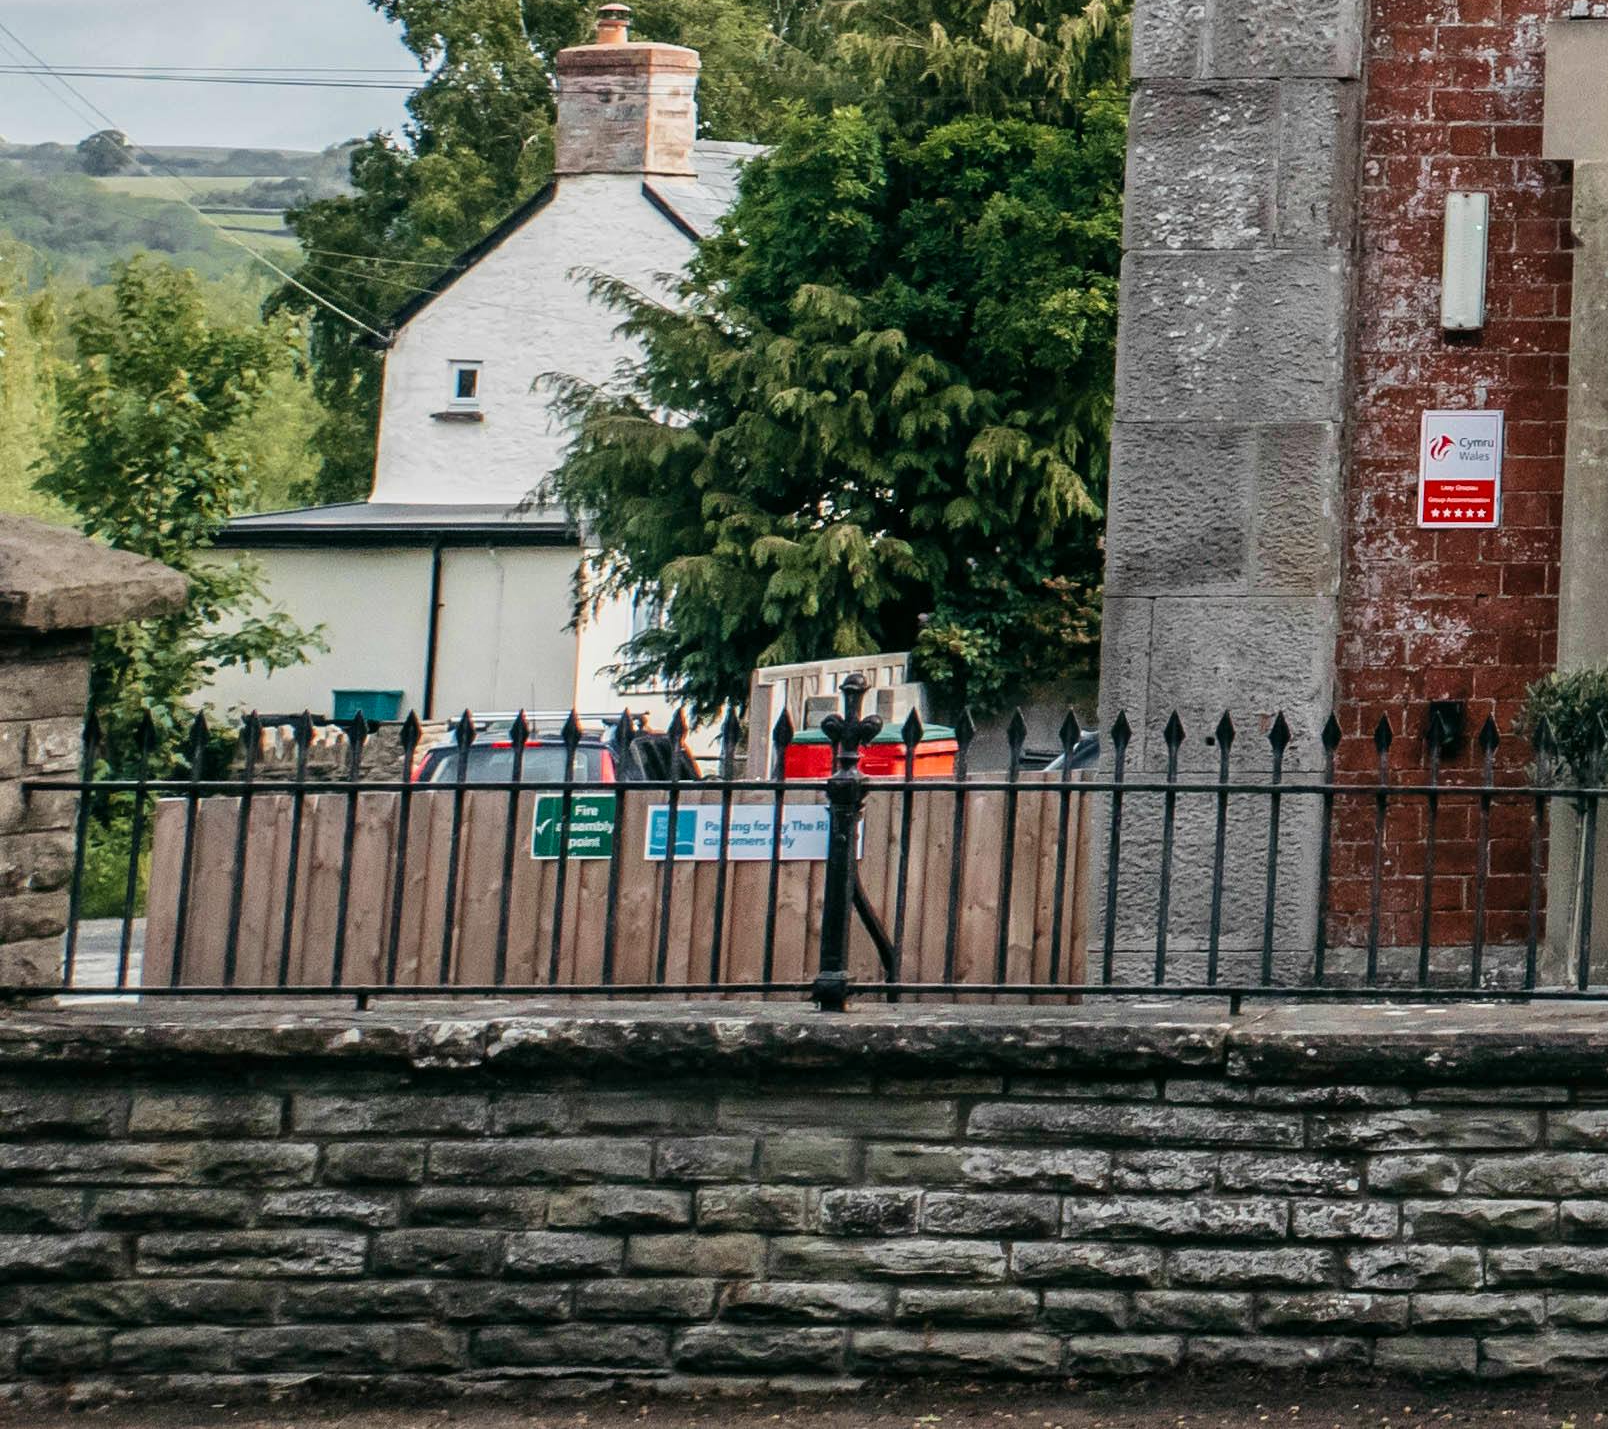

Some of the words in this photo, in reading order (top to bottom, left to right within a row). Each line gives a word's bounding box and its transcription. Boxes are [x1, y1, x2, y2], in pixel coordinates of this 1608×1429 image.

[1459, 437, 1494, 450] Cymru
[1459, 451, 1490, 461] Wales
[574, 805, 599, 816] Fire
[555, 821, 614, 834] asembly
[704, 821, 751, 834] Paing
[753, 820, 771, 830] for
[791, 820, 814, 831] The
[568, 836, 601, 850] point
[704, 837, 766, 846] cuomers
